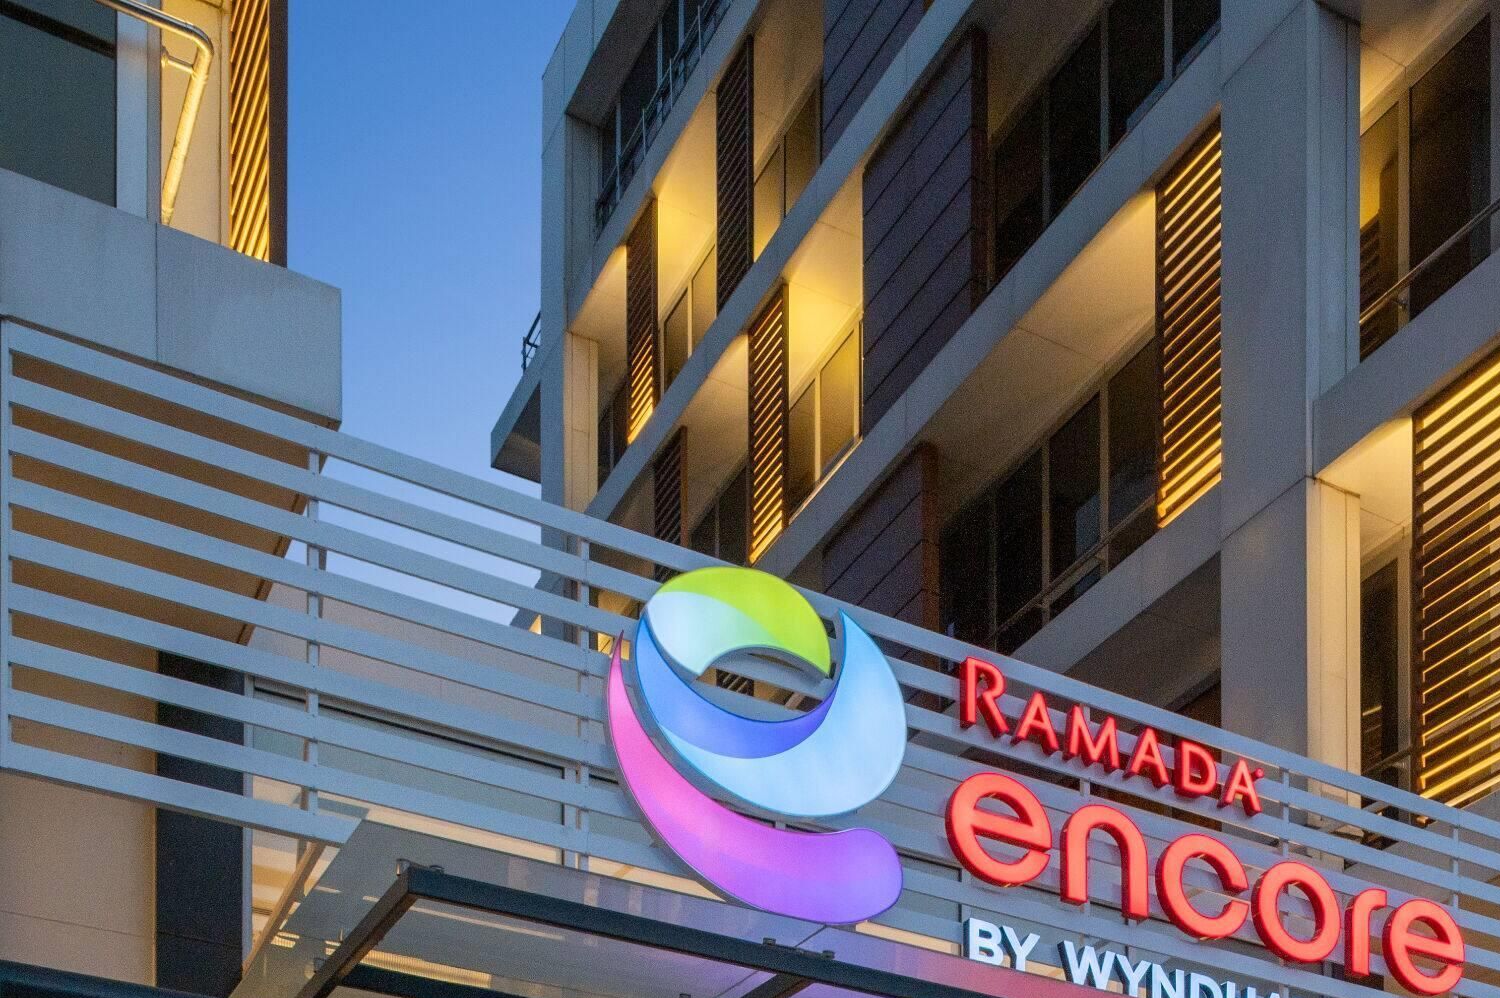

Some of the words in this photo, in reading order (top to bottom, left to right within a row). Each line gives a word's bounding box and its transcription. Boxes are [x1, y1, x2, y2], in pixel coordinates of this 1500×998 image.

[960, 656, 1264, 816] RAMADA
[946, 772, 1465, 996] encore
[964, 917, 1041, 972] BY
